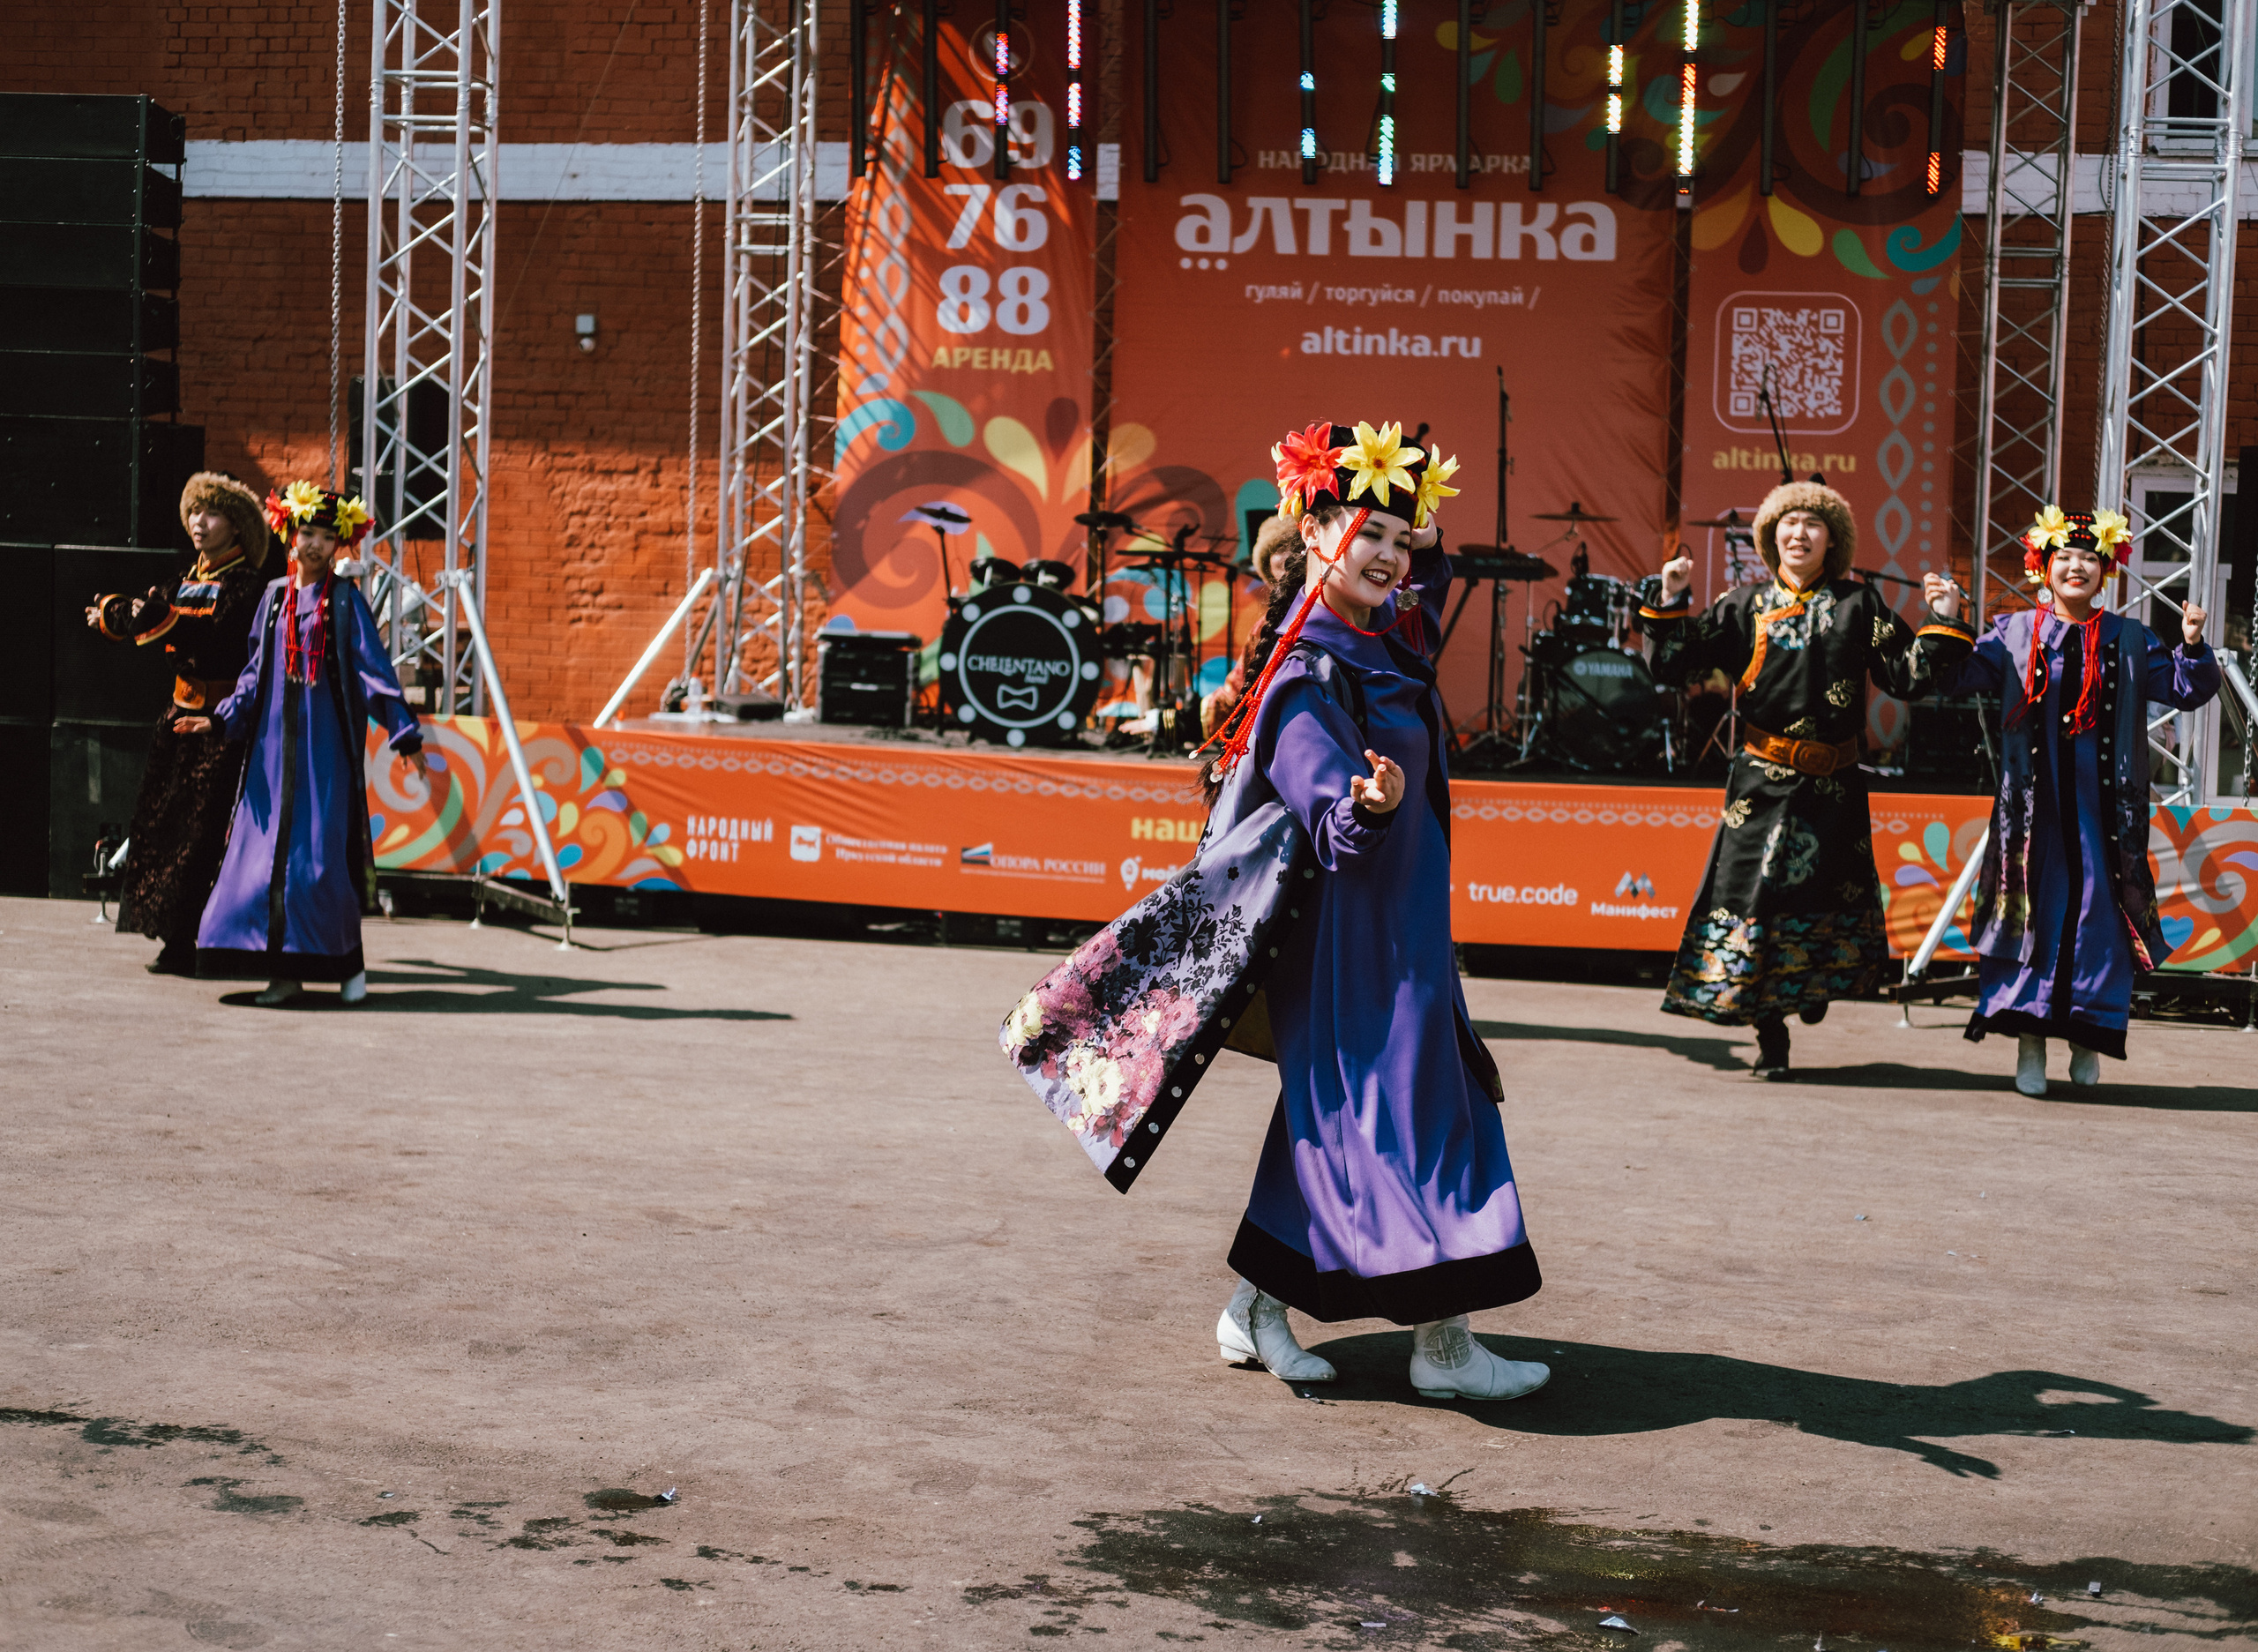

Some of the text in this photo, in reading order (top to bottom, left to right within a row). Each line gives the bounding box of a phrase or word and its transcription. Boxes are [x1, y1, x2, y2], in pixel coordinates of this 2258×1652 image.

[941, 99, 1055, 169] 69
[943, 183, 1050, 252] 76
[936, 265, 1050, 335] 88
[1245, 281, 1303, 303] гуляй
[1324, 283, 1416, 307] торгуйся
[1438, 285, 1524, 309] покупай
[1300, 325, 1482, 358] altinka.ru
[931, 346, 1054, 375] АРЕНДА
[967, 654, 1071, 676] CHELENTANO
[1588, 662, 1634, 678] YAMAHA
[687, 814, 774, 841] НАРОДНЫЙ
[1131, 817, 1206, 842] наш
[686, 838, 739, 863] ФРОНТ
[991, 854, 1106, 876] ОПОРА РОССИИ
[1468, 881, 1579, 907] true.code
[1590, 901, 1679, 922] Манифест
